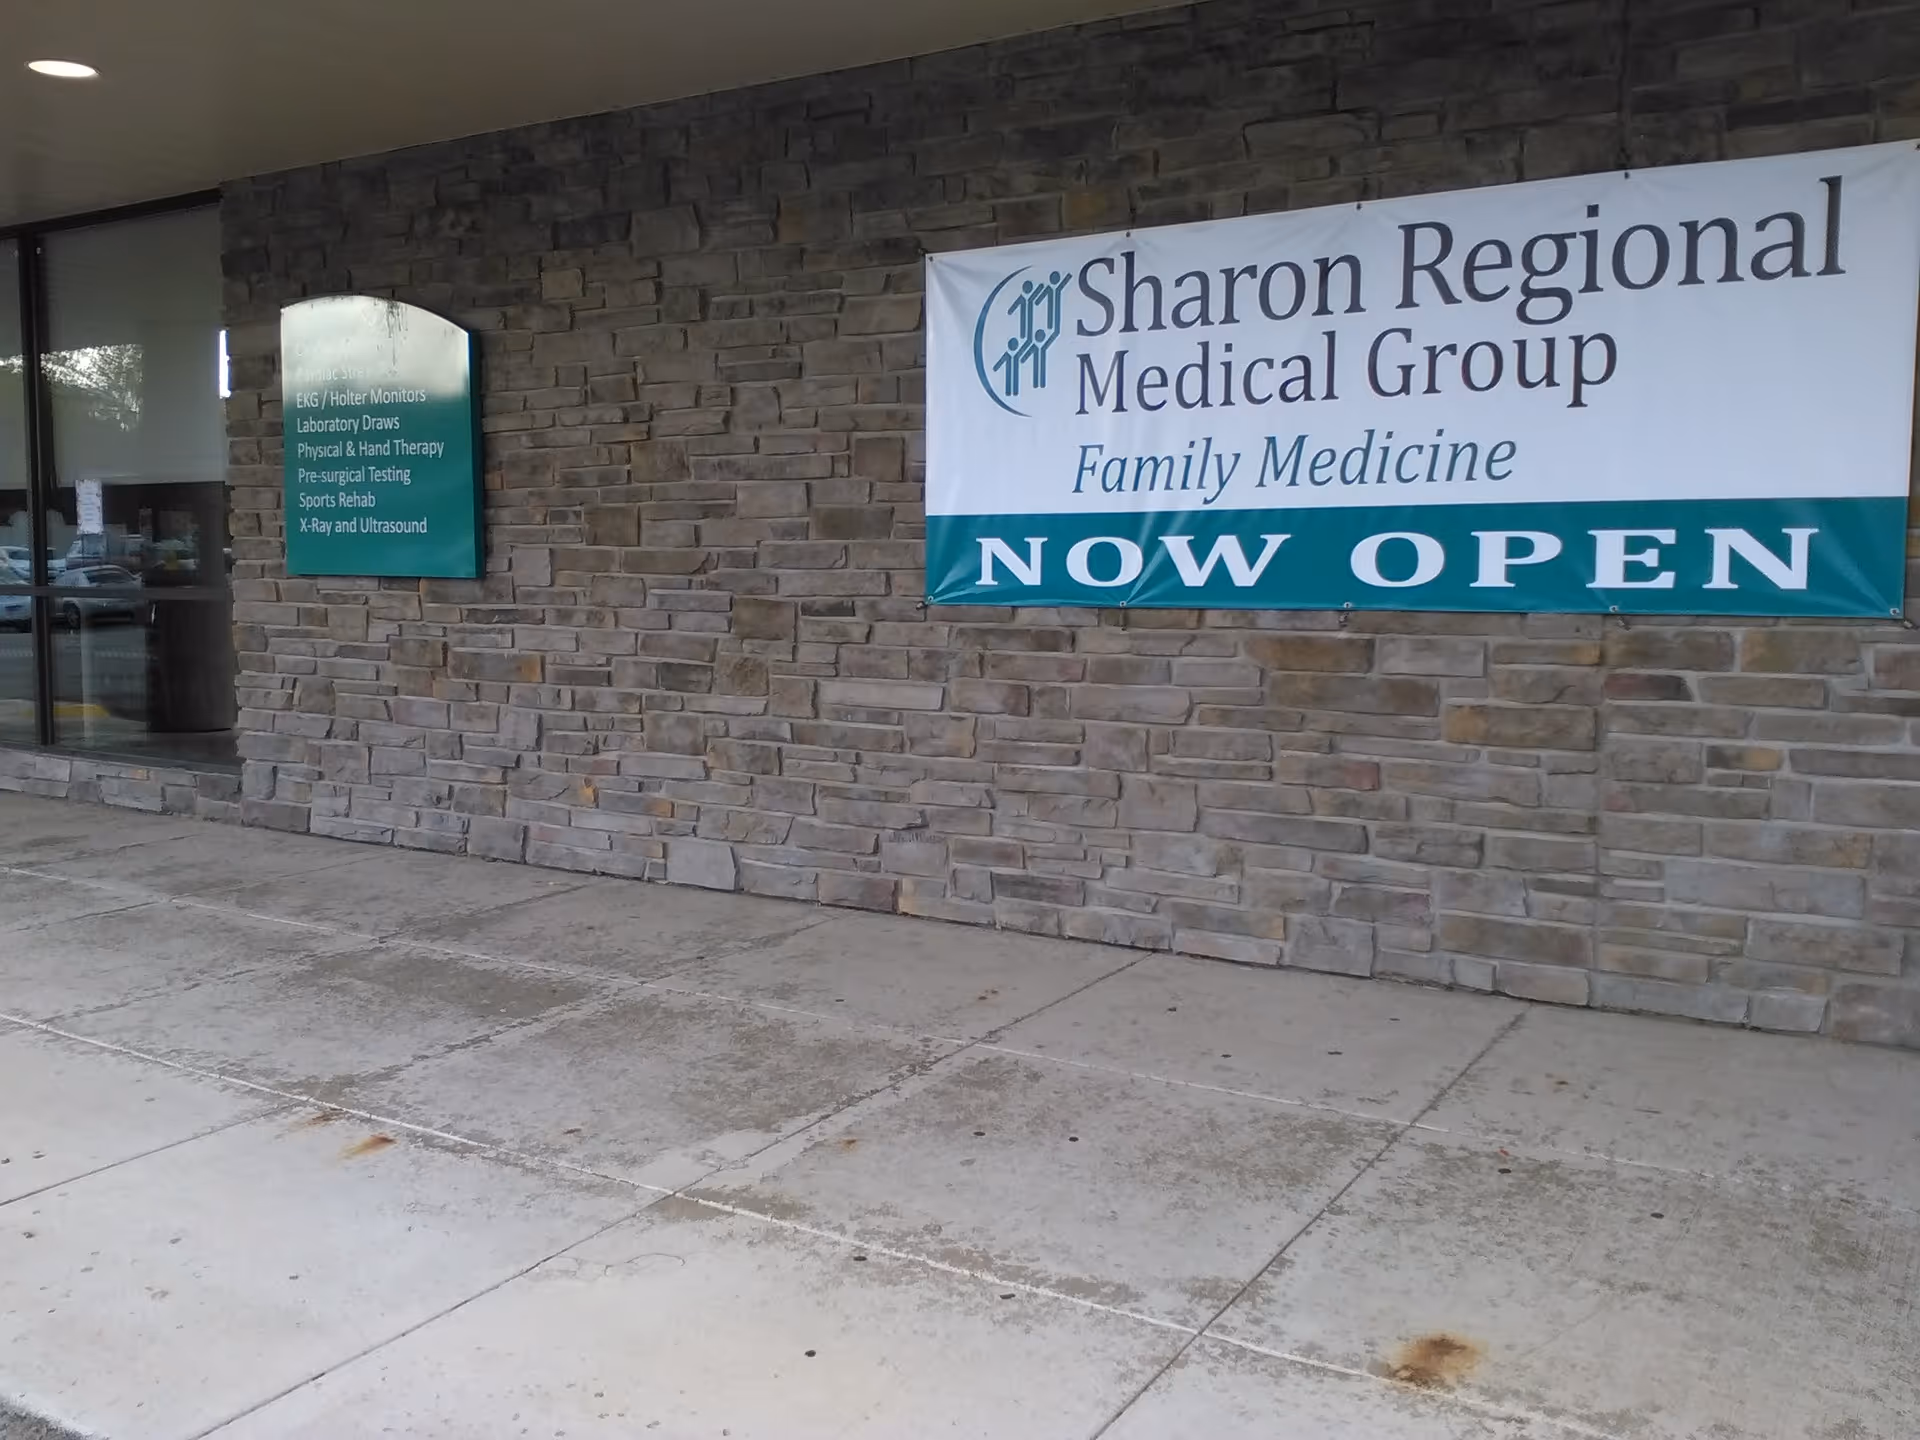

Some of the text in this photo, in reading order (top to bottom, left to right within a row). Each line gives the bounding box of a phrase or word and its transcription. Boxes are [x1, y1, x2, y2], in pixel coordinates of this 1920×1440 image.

[1076, 174, 1847, 337] Sharon Regional
[1075, 328, 1618, 416] Medical Group
[296, 391, 319, 408] EKG
[330, 388, 367, 406] Holter
[370, 387, 426, 404] Monitors
[297, 414, 400, 434] Laboratory Draws
[297, 438, 444, 461] Physical & Hand Therapy
[298, 465, 411, 486] Pre-surgical Testing
[1071, 429, 1517, 505] Family Medicine
[299, 490, 376, 511] Sports Rehab
[300, 516, 427, 536] X-Ray and Ultrasound
[974, 528, 1820, 590] NOW OPEN
